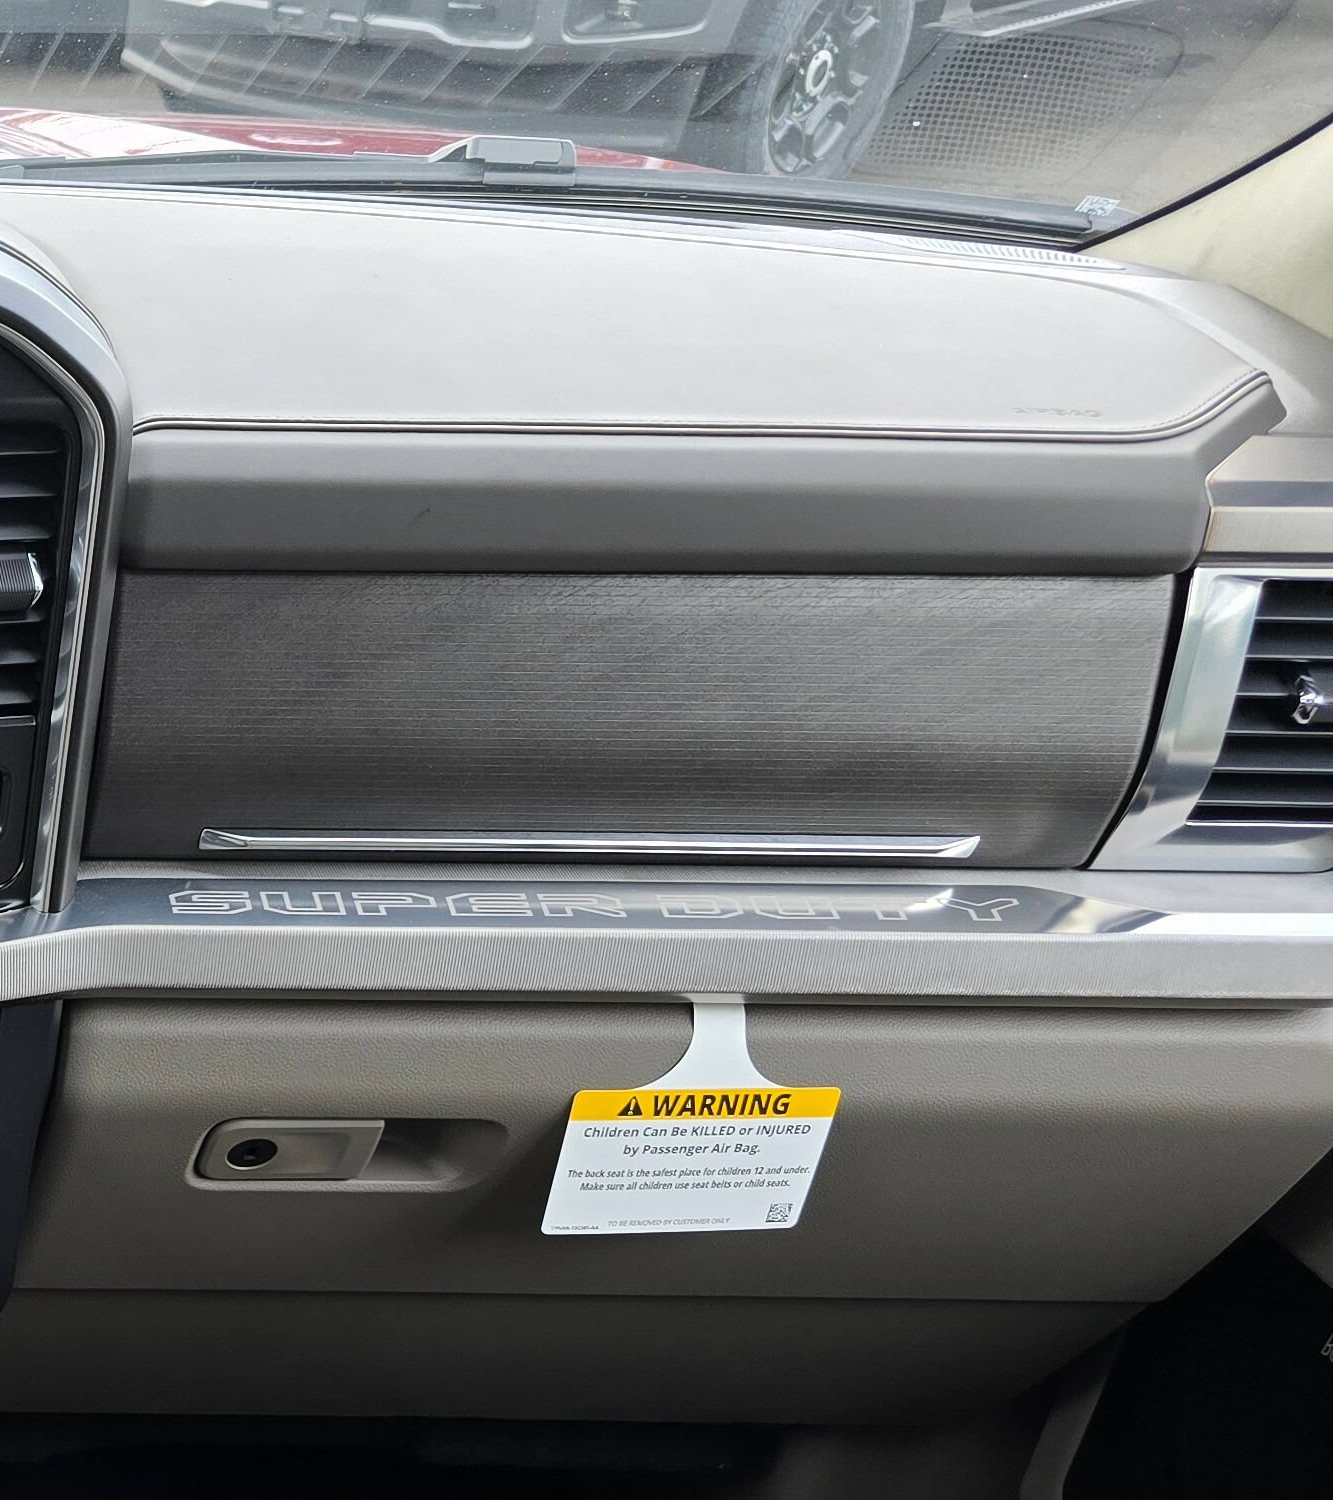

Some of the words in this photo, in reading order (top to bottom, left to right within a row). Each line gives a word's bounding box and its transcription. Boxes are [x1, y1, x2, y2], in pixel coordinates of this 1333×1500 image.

[167, 890, 628, 918] SUPER
[654, 892, 1020, 922] DUTY
[652, 1093, 791, 1116] WARNING
[583, 1126, 639, 1137] Children
[642, 1126, 667, 1136] Can
[670, 1126, 687, 1136] Be
[690, 1125, 735, 1136] KILLED
[738, 1127, 753, 1135] or
[755, 1124, 811, 1137] INJURED
[622, 1144, 639, 1157] by
[641, 1144, 709, 1156] Passenger
[710, 1142, 731, 1153] Air
[733, 1143, 760, 1155] Bag.
[567, 1169, 583, 1177] The
[584, 1169, 605, 1177] back
[626, 1168, 634, 1177] is
[635, 1168, 650, 1177] the
[651, 1167, 677, 1177] safest
[678, 1167, 701, 1179] place
[702, 1167, 716, 1176] for
[717, 1166, 751, 1175] children
[754, 1166, 764, 1175] 12
[765, 1166, 782, 1175] and
[783, 1165, 810, 1175] under.
[579, 1182, 604, 1190] Make
[625, 1181, 637, 1190] all
[638, 1181, 672, 1190] children
[690, 1181, 709, 1189] seat
[710, 1179, 732, 1188] belts
[744, 1178, 765, 1187] child
[765, 1179, 789, 1187] seats.
